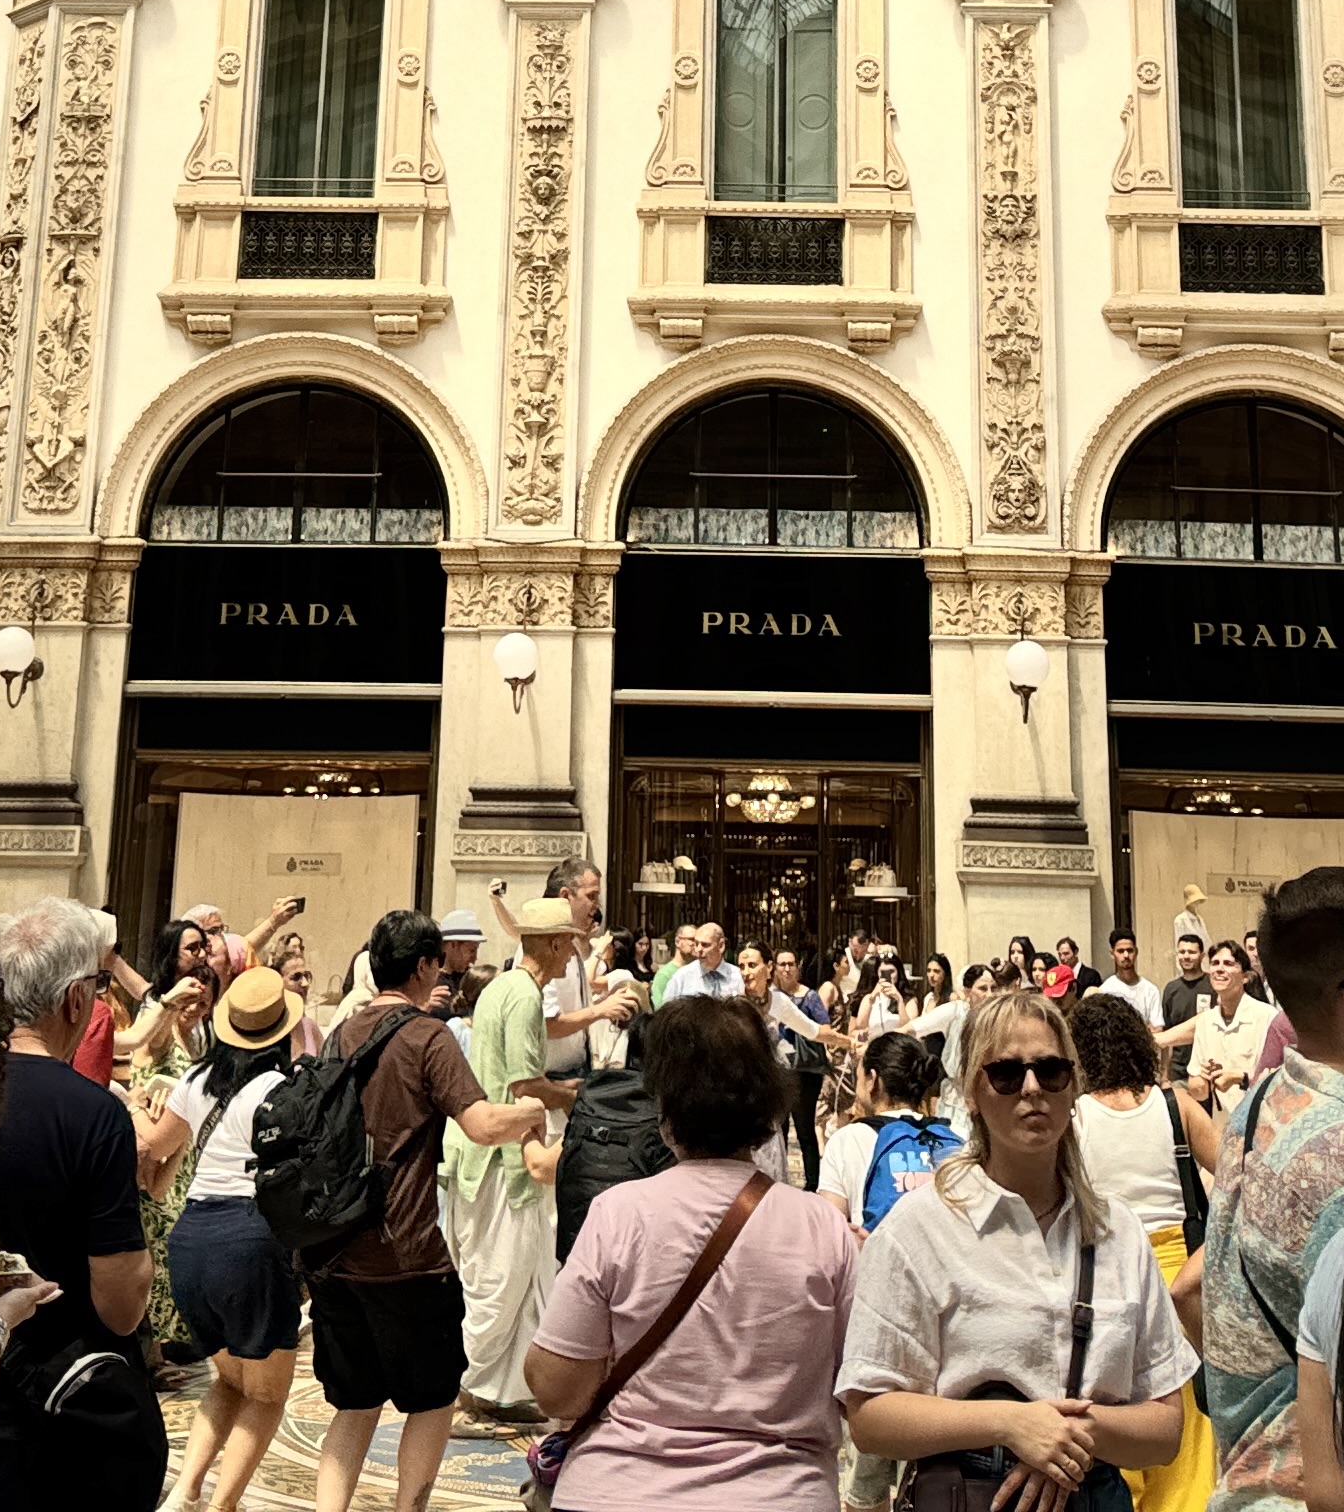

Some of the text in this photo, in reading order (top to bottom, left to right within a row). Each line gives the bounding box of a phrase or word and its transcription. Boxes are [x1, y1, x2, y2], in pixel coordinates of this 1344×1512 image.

[219, 602, 359, 626] PRADA
[702, 612, 843, 637] PRADA
[1193, 622, 1338, 649] PRADA
